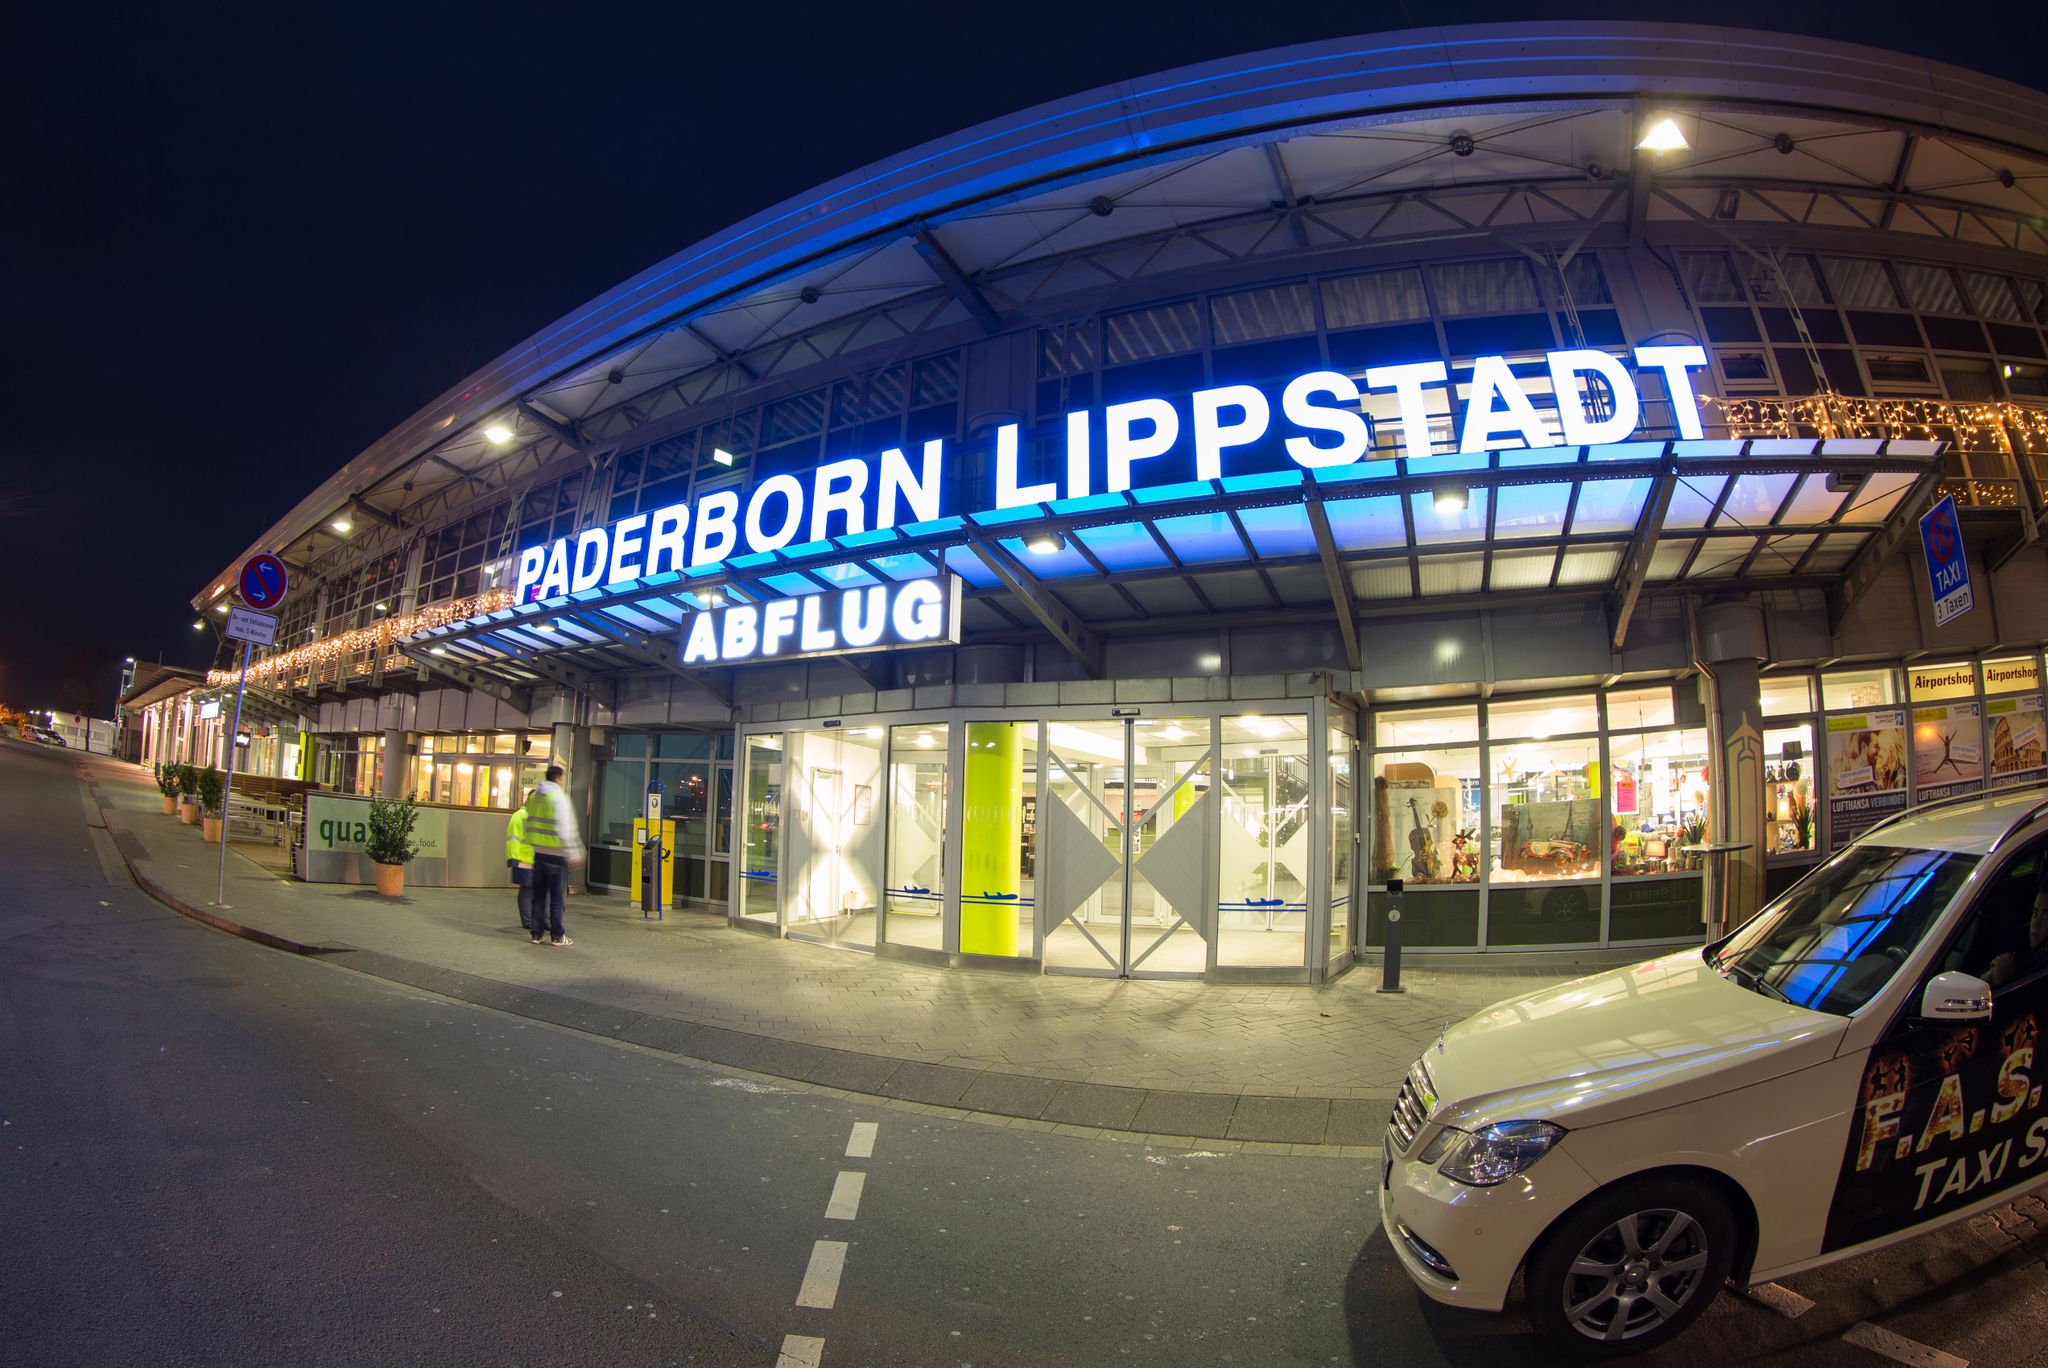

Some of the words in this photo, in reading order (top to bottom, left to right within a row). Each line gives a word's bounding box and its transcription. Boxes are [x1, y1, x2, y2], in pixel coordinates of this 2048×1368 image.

[514, 438, 943, 605] PADERBORN
[995, 345, 1708, 509] LIPPSTADT
[1936, 560, 1961, 592] TAXI
[1936, 602, 1943, 618] 3
[1945, 592, 1968, 614] Taxen
[683, 579, 944, 663] ABFLUG
[1915, 672, 1974, 689] Airportshop
[1986, 666, 2038, 682] Airportshop
[1832, 798, 1870, 813] LUFTHANSA
[1870, 793, 1905, 809] VERBINDET
[1918, 786, 1951, 801] LUFTHANSA
[320, 819, 369, 848] qua
[419, 838, 438, 848] food.
[1913, 1138, 2013, 1212] TAXI
[2018, 1116, 2048, 1168] S
